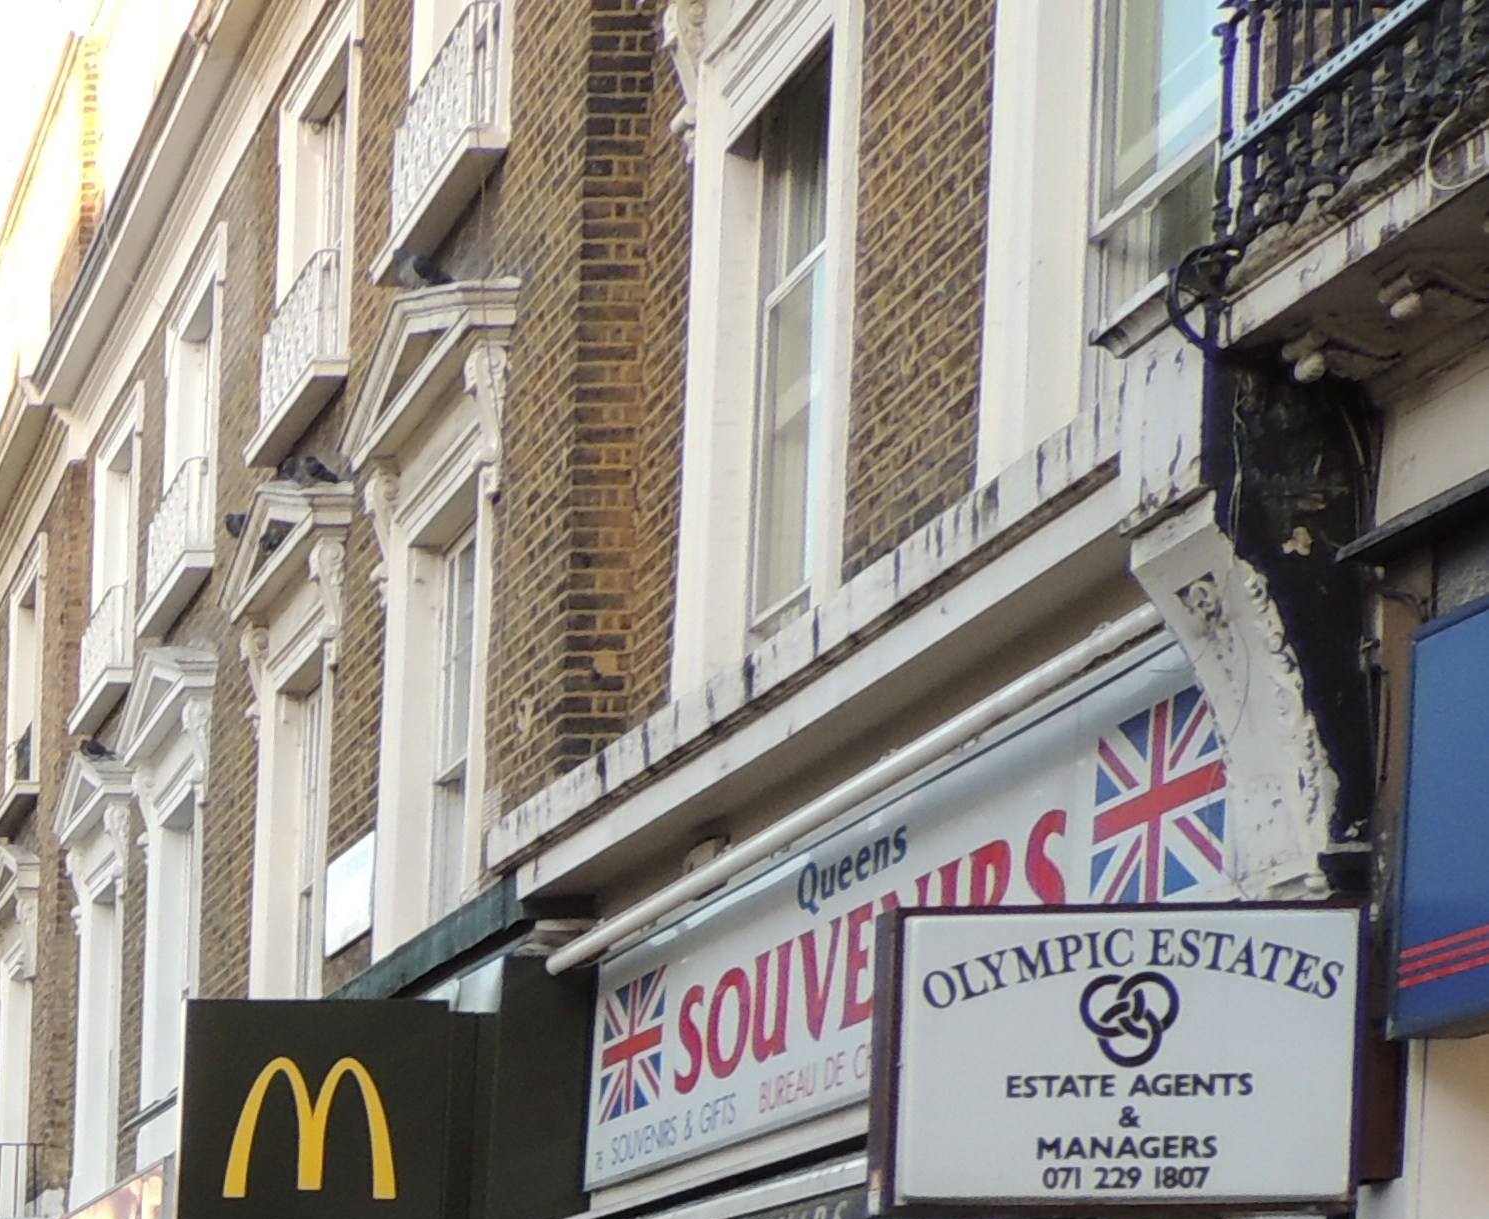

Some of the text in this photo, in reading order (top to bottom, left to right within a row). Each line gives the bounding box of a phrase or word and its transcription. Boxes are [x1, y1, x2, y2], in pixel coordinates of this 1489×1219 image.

[796, 825, 909, 914] Queens
[922, 928, 1345, 1009] OLYMPIC ESTATES
[1006, 1072, 1254, 1098] ESTATE AGENTS
[610, 1119, 678, 1166] SOUVENIRS
[699, 1092, 737, 1133] GIFTS
[759, 1069, 817, 1113] BUREAU
[823, 1057, 845, 1089] DE
[1118, 1106, 1141, 1128] &
[1037, 1135, 1219, 1160] MANAGERS
[1043, 1165, 1210, 1190] 071 229 1807
